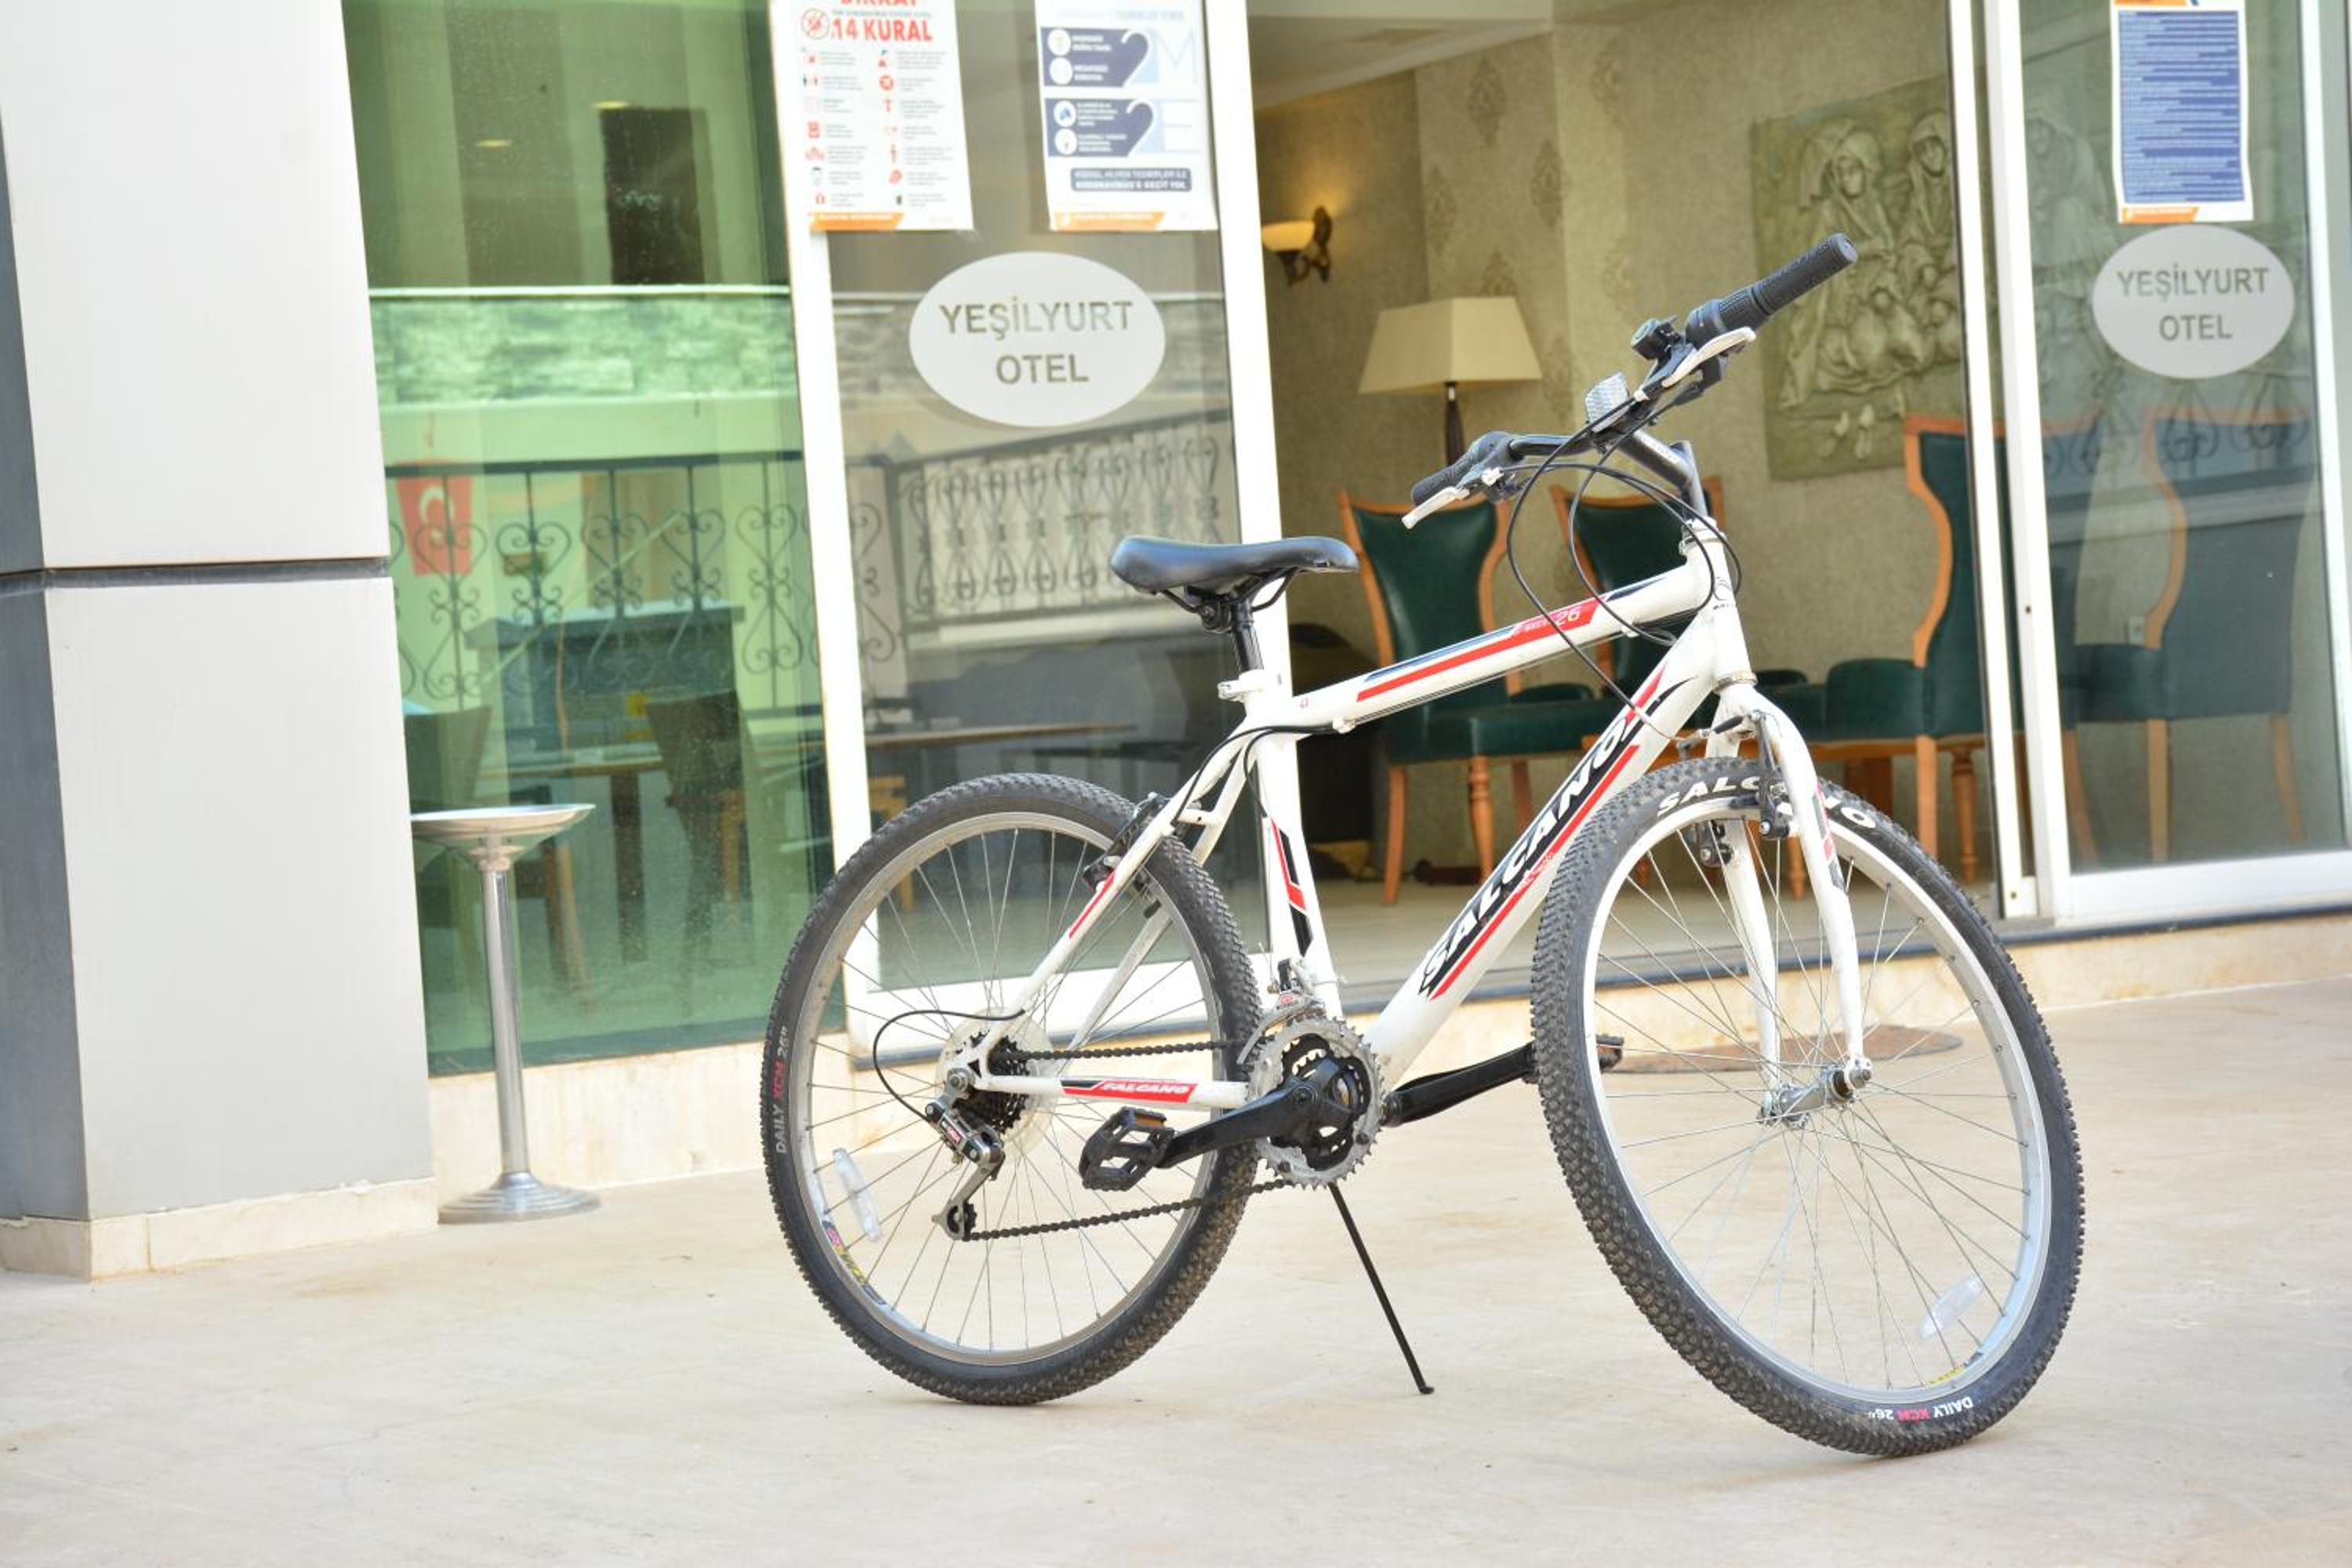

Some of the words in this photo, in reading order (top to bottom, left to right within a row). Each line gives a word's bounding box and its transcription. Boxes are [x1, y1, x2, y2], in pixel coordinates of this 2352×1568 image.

[833, 17, 858, 40] 14
[863, 19, 934, 42] KURAL
[2118, 264, 2269, 302] YEŞİLYURT
[940, 296, 1133, 340] YEŞİLYURT
[2159, 314, 2233, 340] OTEL
[996, 354, 1089, 384] OTEL
[1420, 715, 1629, 994] SALCANO
[772, 1104, 787, 1153] DAILY
[1933, 1396, 1974, 1418] DAILY
